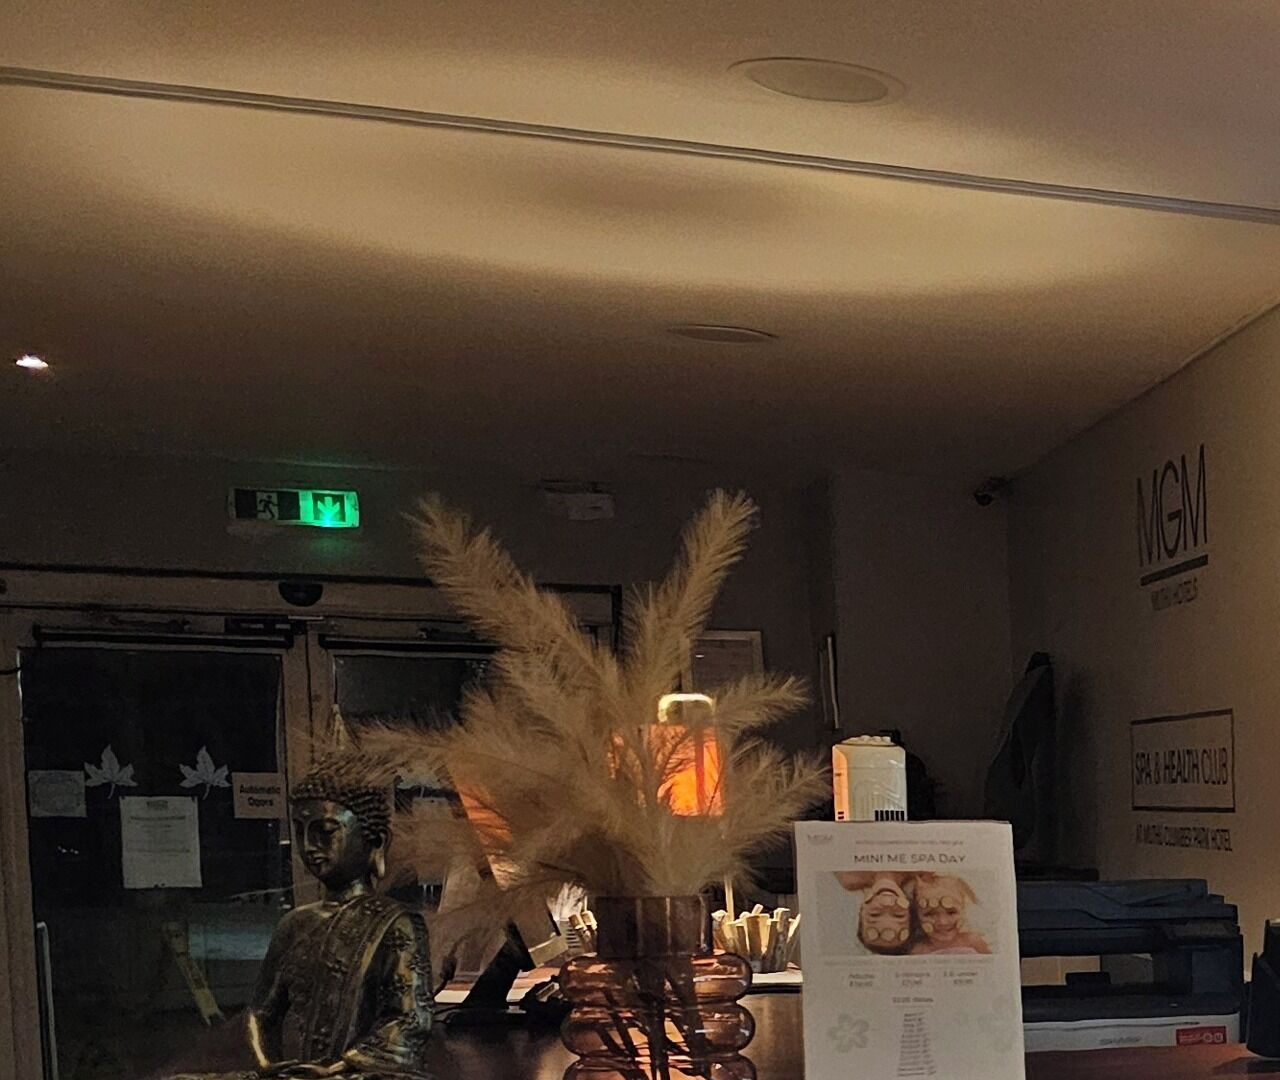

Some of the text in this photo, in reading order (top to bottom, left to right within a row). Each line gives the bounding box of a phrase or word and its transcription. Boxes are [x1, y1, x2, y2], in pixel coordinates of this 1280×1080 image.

[1137, 443, 1207, 567] MGM
[1135, 747, 1228, 785] SPA & HEALTH CLUB
[1211, 828, 1232, 852] HOTEL
[854, 853, 966, 864] MINI ME SPA DAY
